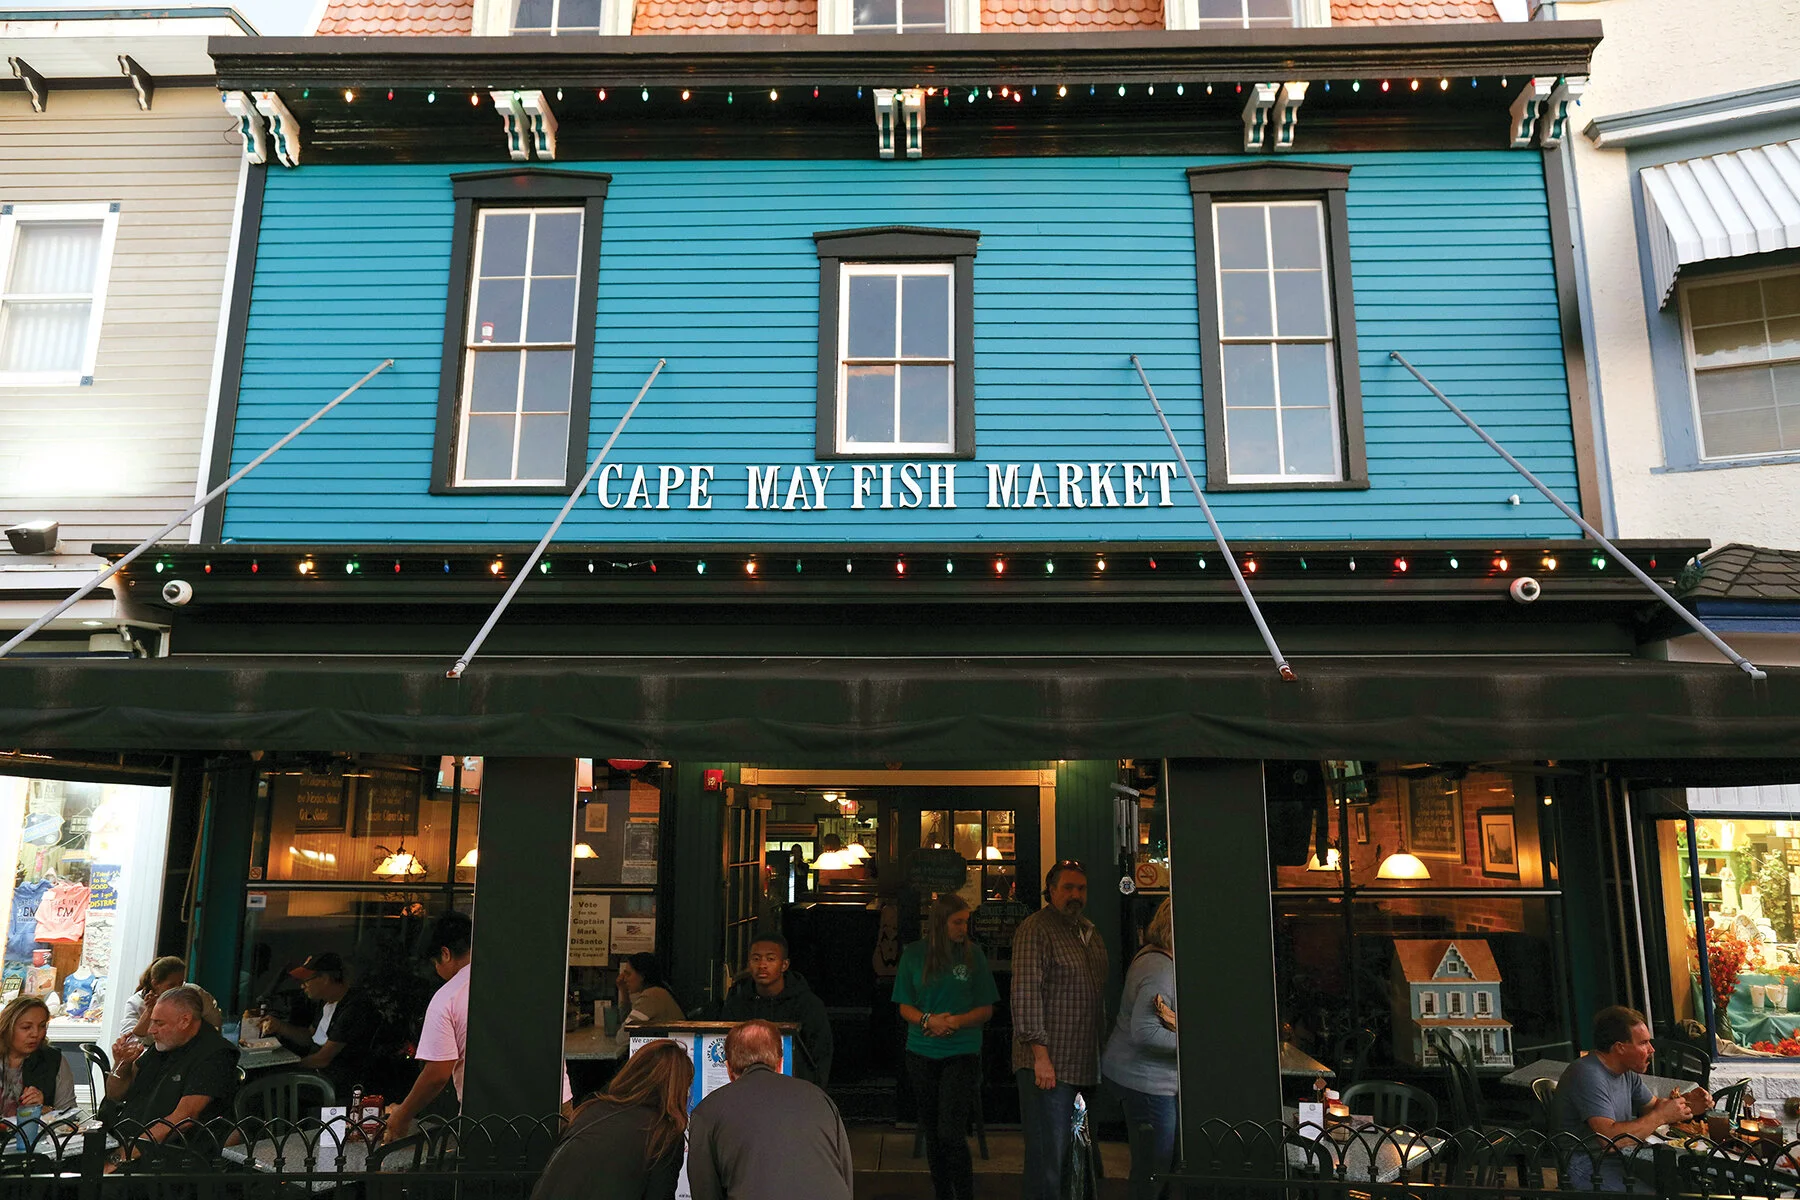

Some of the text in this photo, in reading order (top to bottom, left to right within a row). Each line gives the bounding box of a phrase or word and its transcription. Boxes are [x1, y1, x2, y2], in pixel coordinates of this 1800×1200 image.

[597, 461, 1178, 511] CAPE MAY FISH MARKET
[57, 907, 74, 917] CM
[573, 918, 605, 926] Captain
